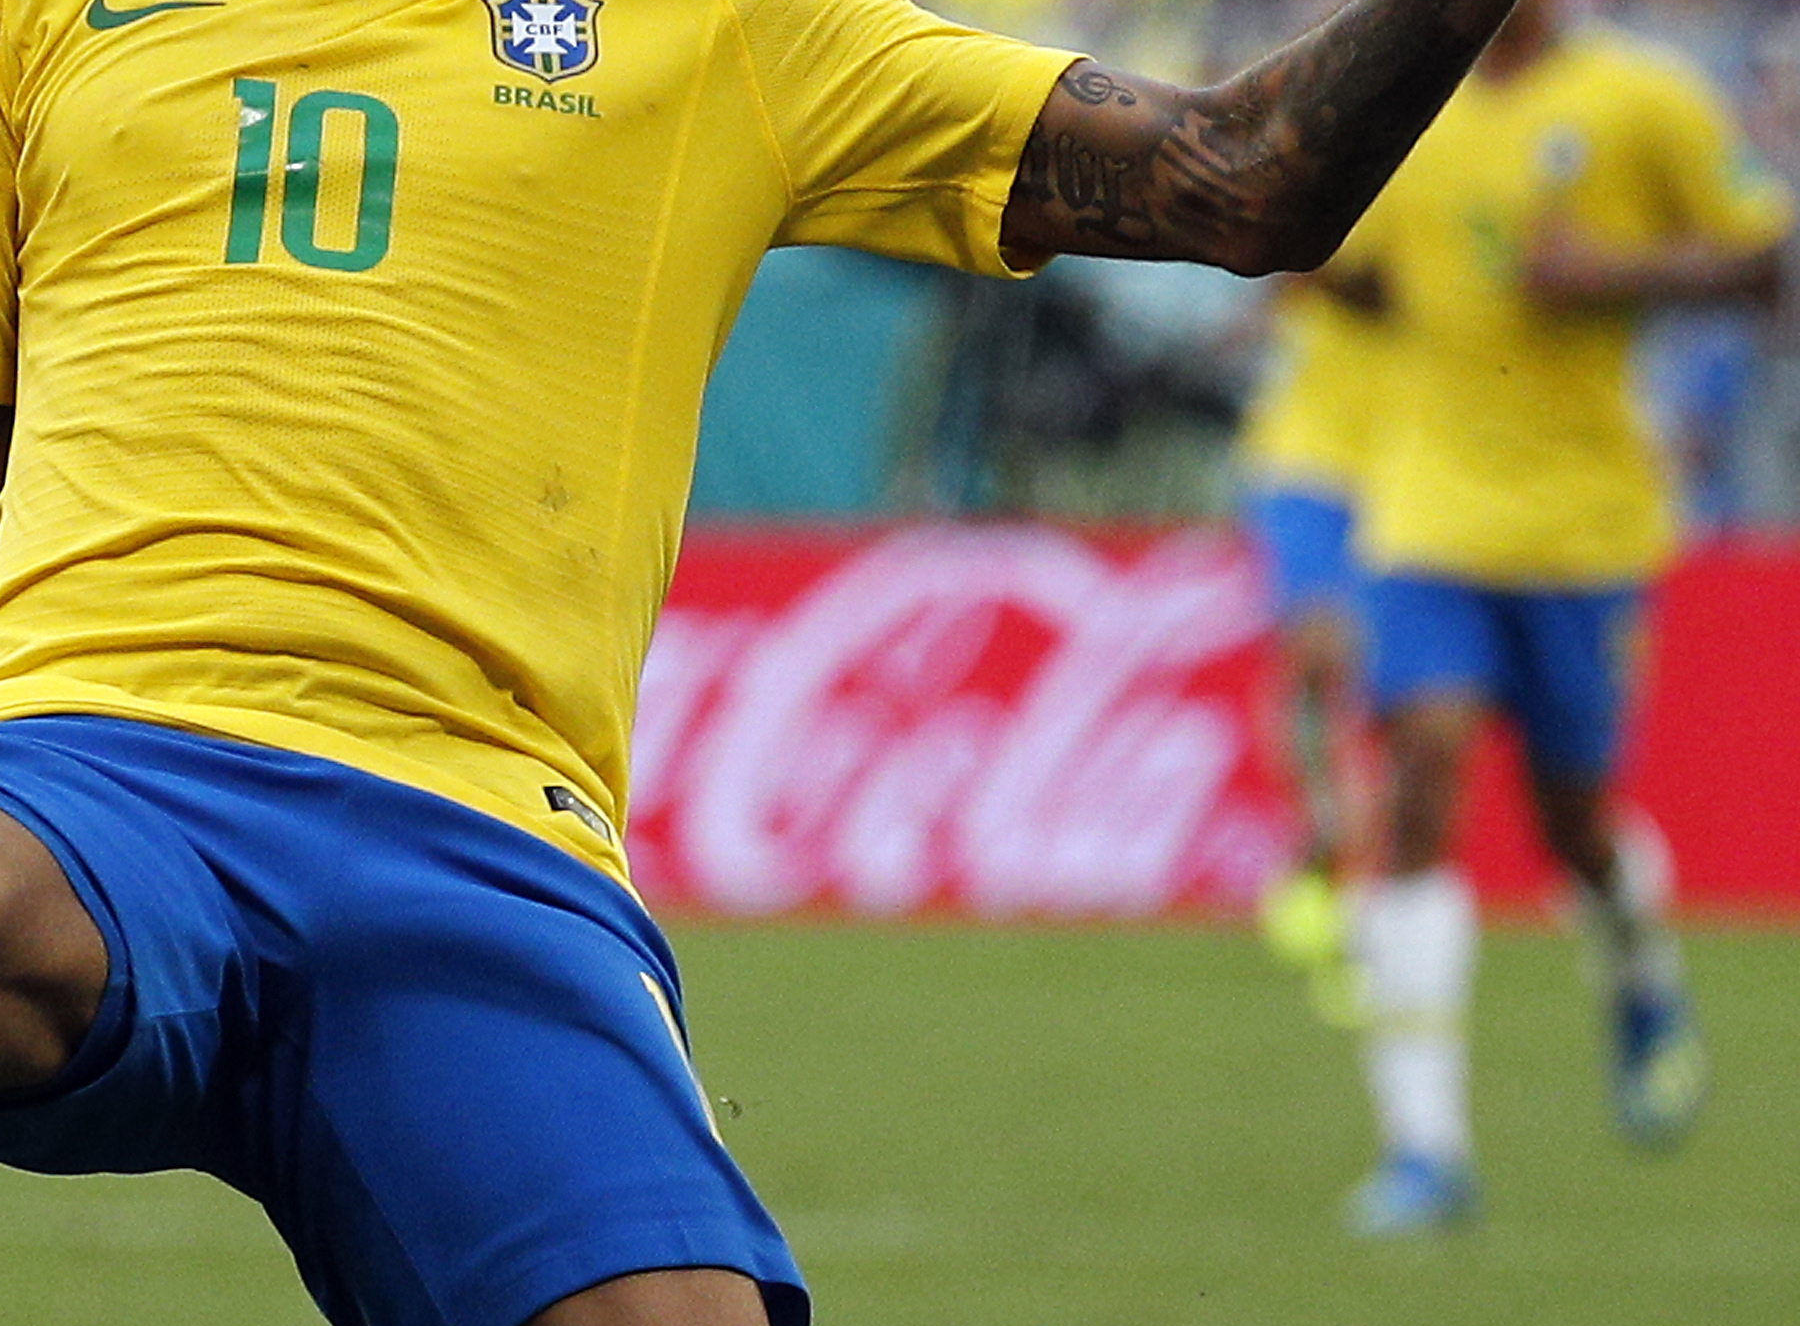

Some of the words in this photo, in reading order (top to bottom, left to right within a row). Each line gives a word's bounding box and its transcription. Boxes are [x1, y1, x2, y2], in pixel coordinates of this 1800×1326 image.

[525, 23, 564, 36] CBF
[493, 84, 602, 118] BRASIL
[224, 77, 400, 273] 10
